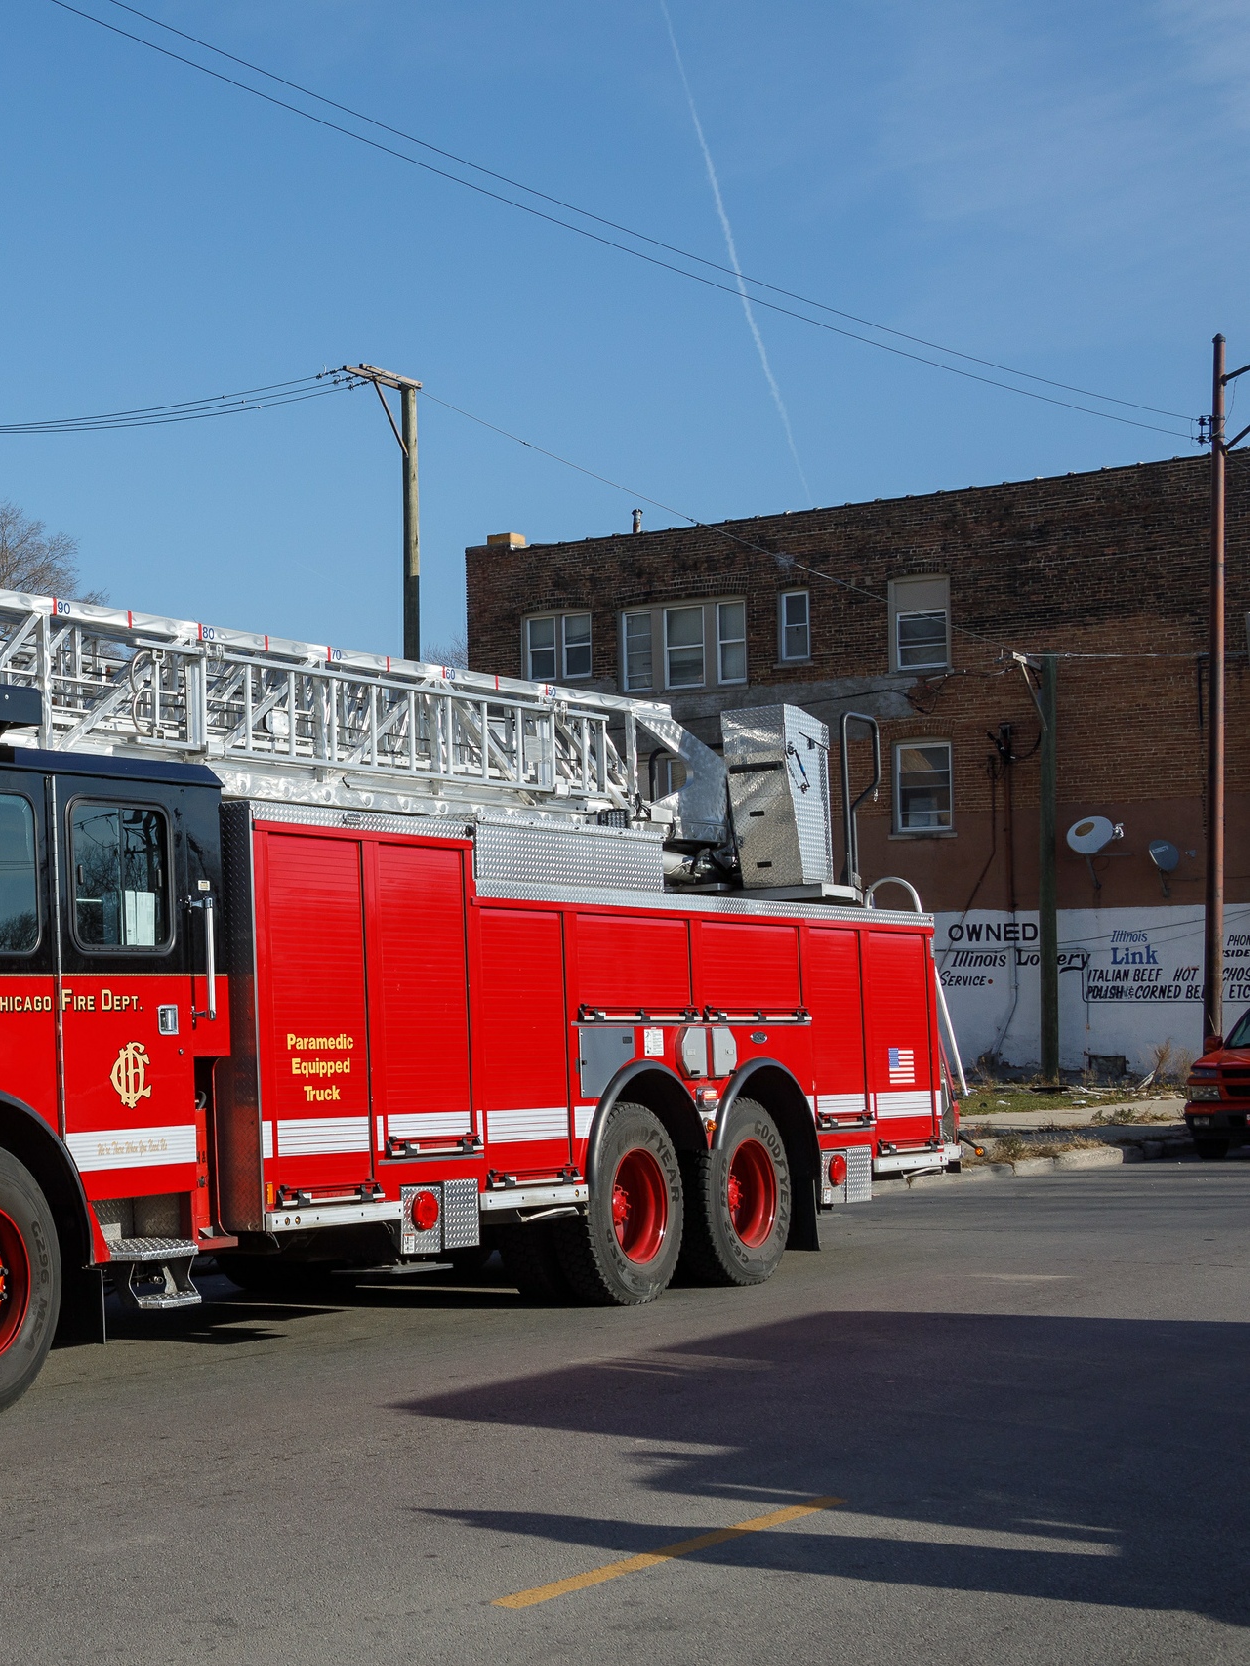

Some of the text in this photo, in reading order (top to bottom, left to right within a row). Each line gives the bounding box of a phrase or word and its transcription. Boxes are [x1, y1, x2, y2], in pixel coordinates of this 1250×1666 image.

[57, 601, 70, 614] 90
[202, 626, 215, 640] 80
[331, 649, 342, 661] 70
[445, 668, 456, 680] 60
[948, 923, 1039, 942] OWNED
[1111, 930, 1148, 943] Illinois
[951, 949, 1091, 975] Illinois Loery
[1111, 944, 1159, 965] Link
[940, 971, 986, 987] SERVICE
[1087, 969, 1130, 982] ITALIAN
[1133, 968, 1163, 982] BEEF
[1172, 967, 1200, 982] HOT
[61, 989, 96, 1011] FIRE
[101, 989, 144, 1011] DEPT.
[1135, 985, 1181, 999] CORNED
[286, 1033, 354, 1050] Paramedic
[291, 1057, 350, 1078] Equipped
[303, 1085, 341, 1102] Truck
